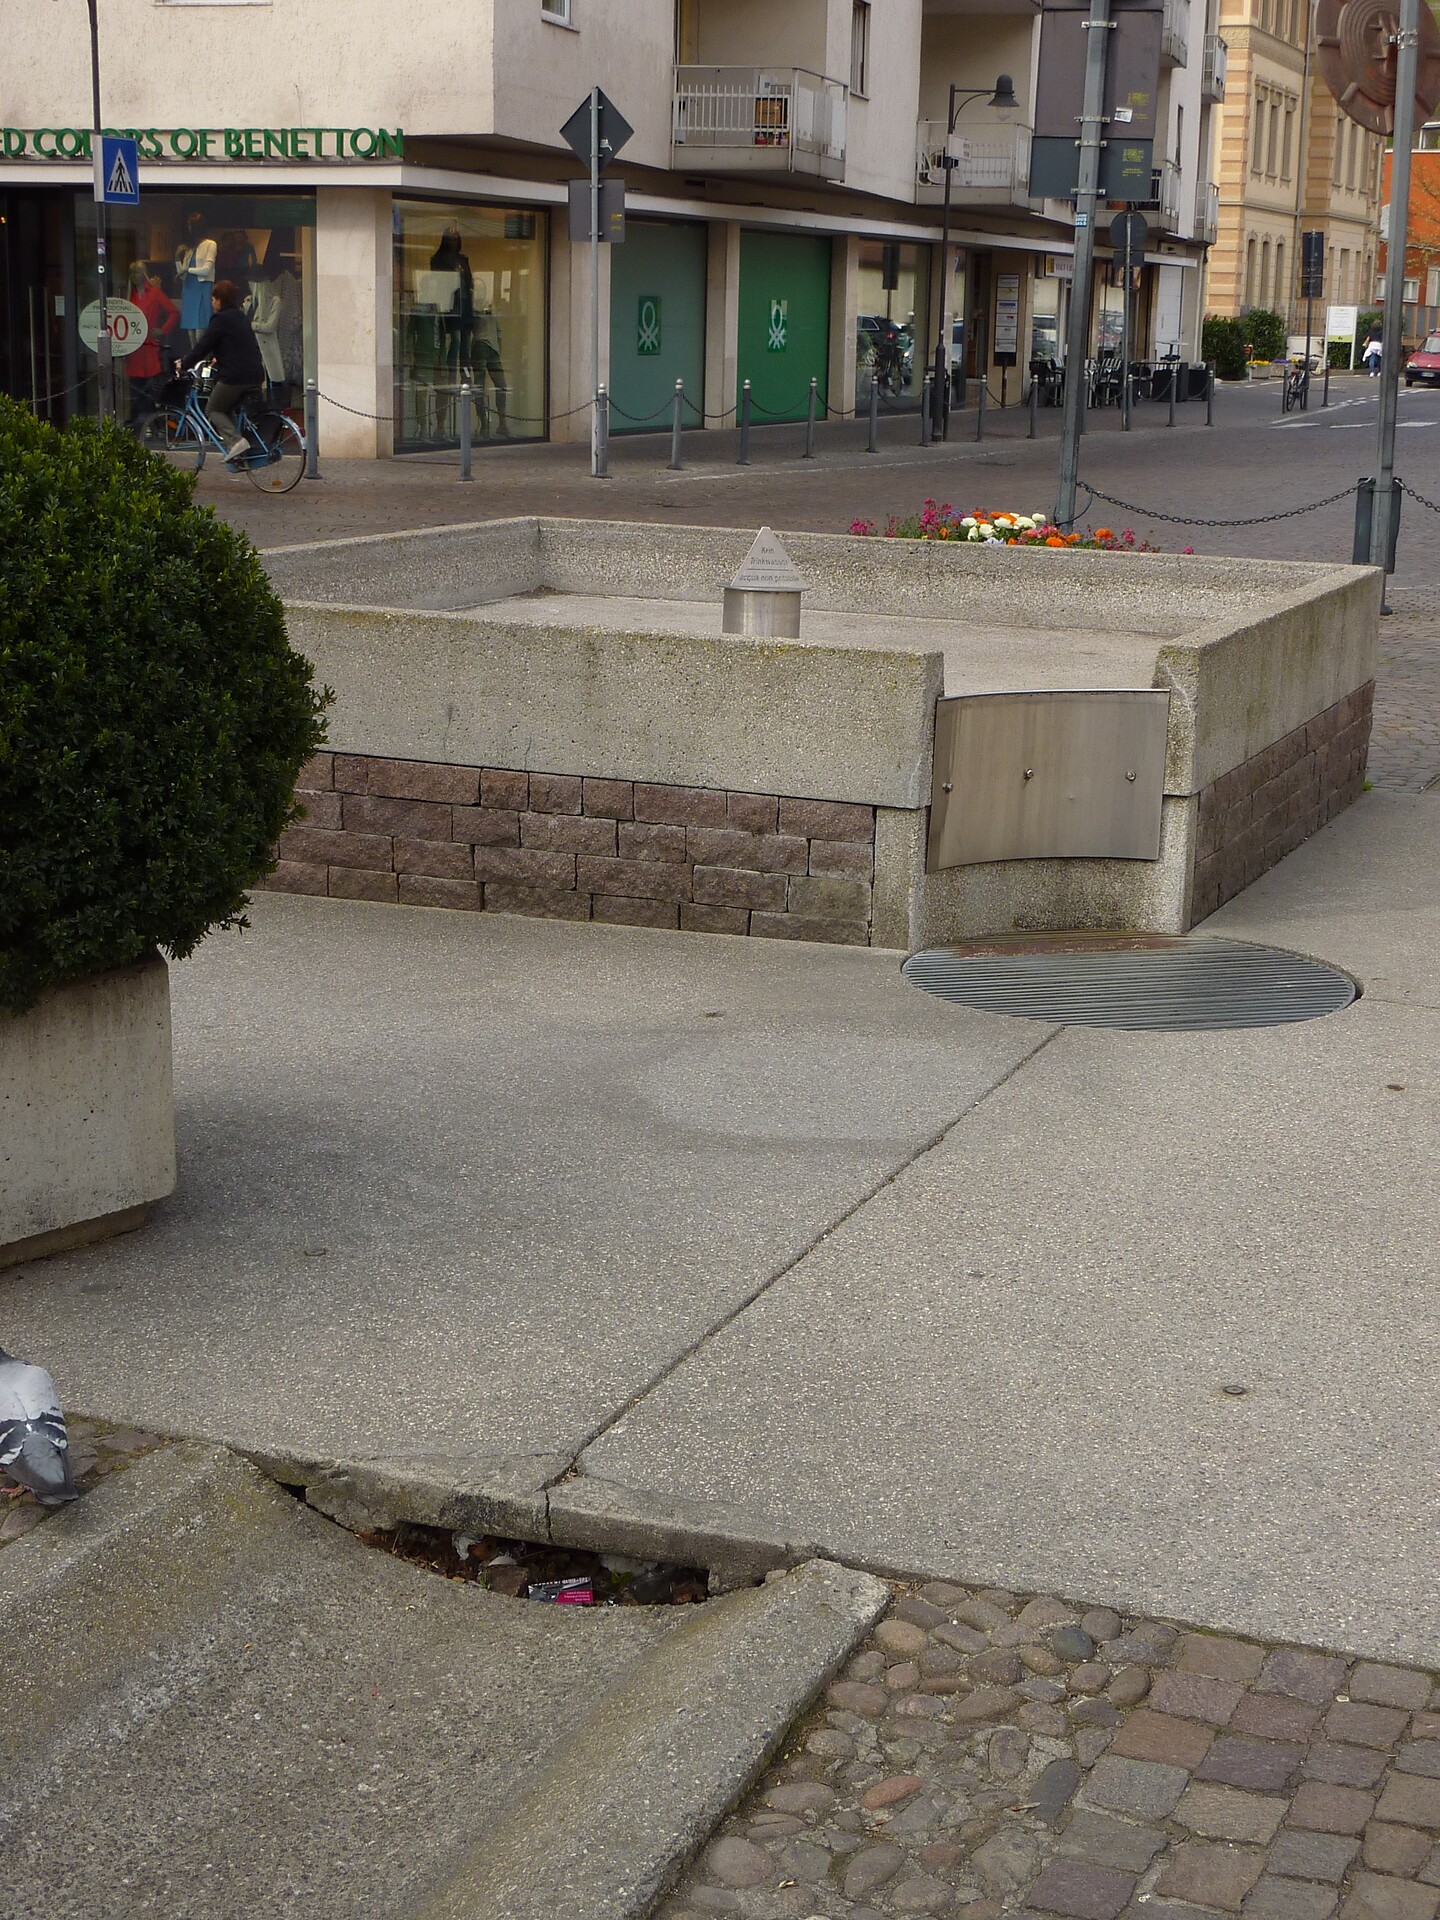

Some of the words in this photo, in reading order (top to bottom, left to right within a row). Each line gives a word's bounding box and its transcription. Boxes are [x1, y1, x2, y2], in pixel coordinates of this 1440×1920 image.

[0, 128, 27, 157] D
[170, 128, 217, 157] OF
[224, 128, 404, 157] BENETTON
